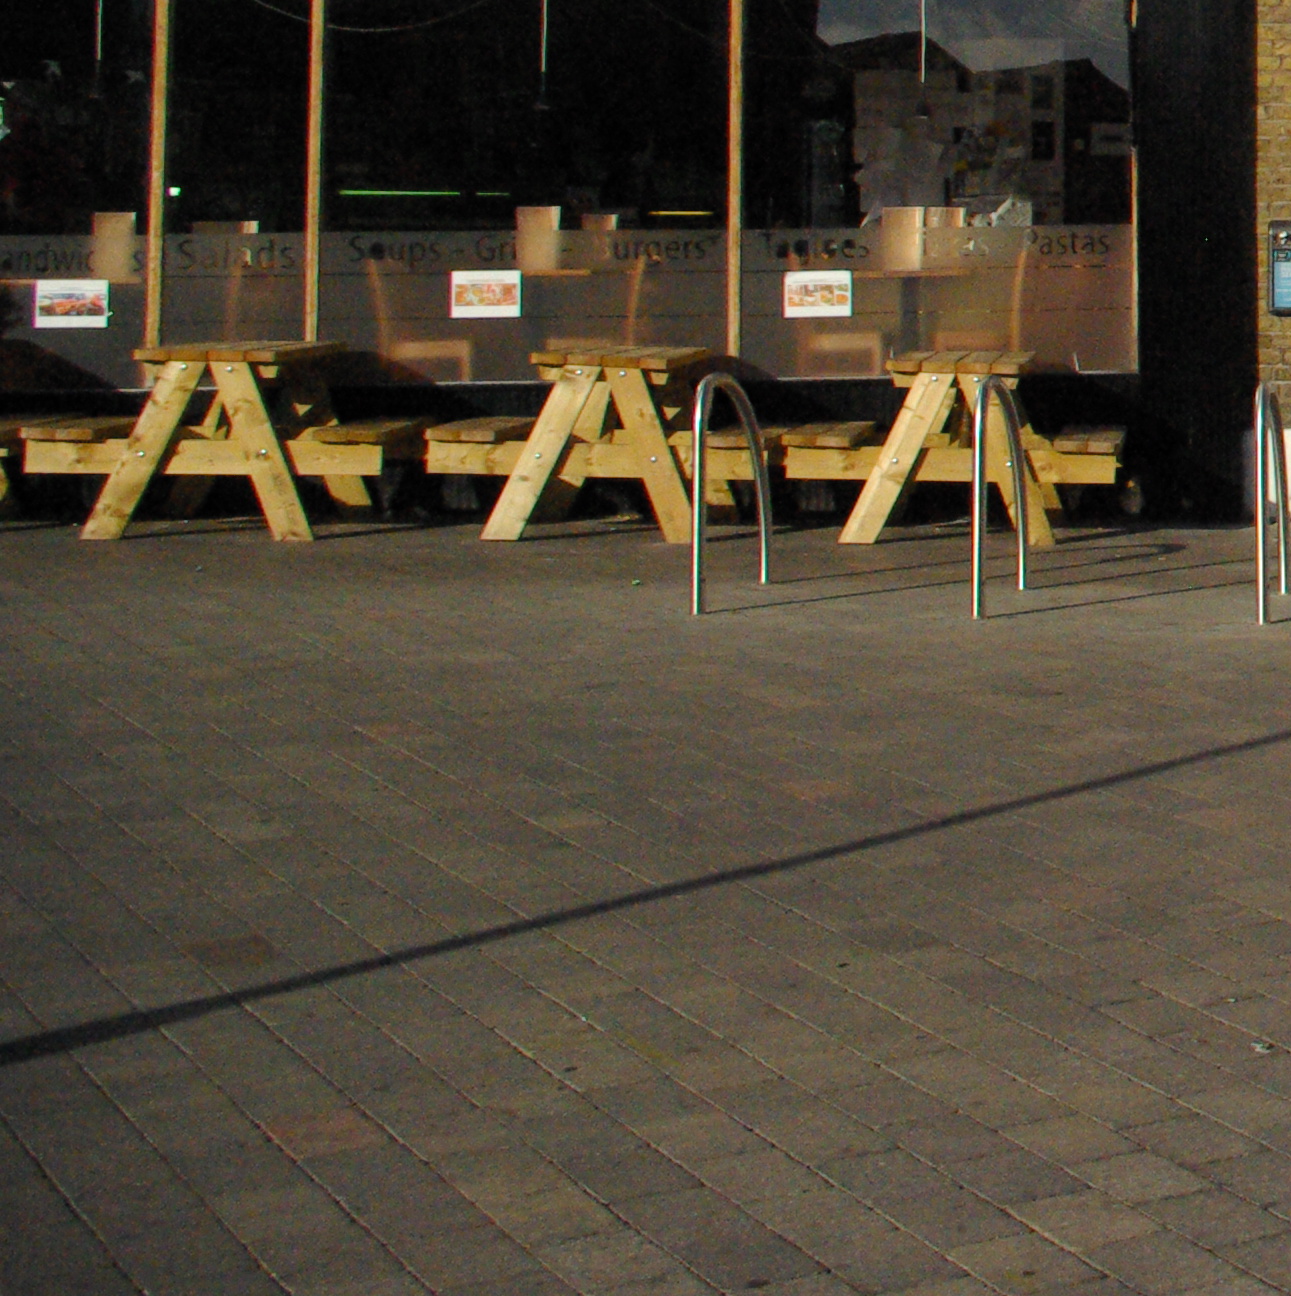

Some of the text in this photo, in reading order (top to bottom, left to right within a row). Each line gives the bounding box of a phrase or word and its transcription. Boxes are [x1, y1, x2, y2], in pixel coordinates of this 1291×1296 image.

[176, 238, 297, 270] Salads
[347, 235, 441, 265] Soups
[602, 237, 707, 268] urgers
